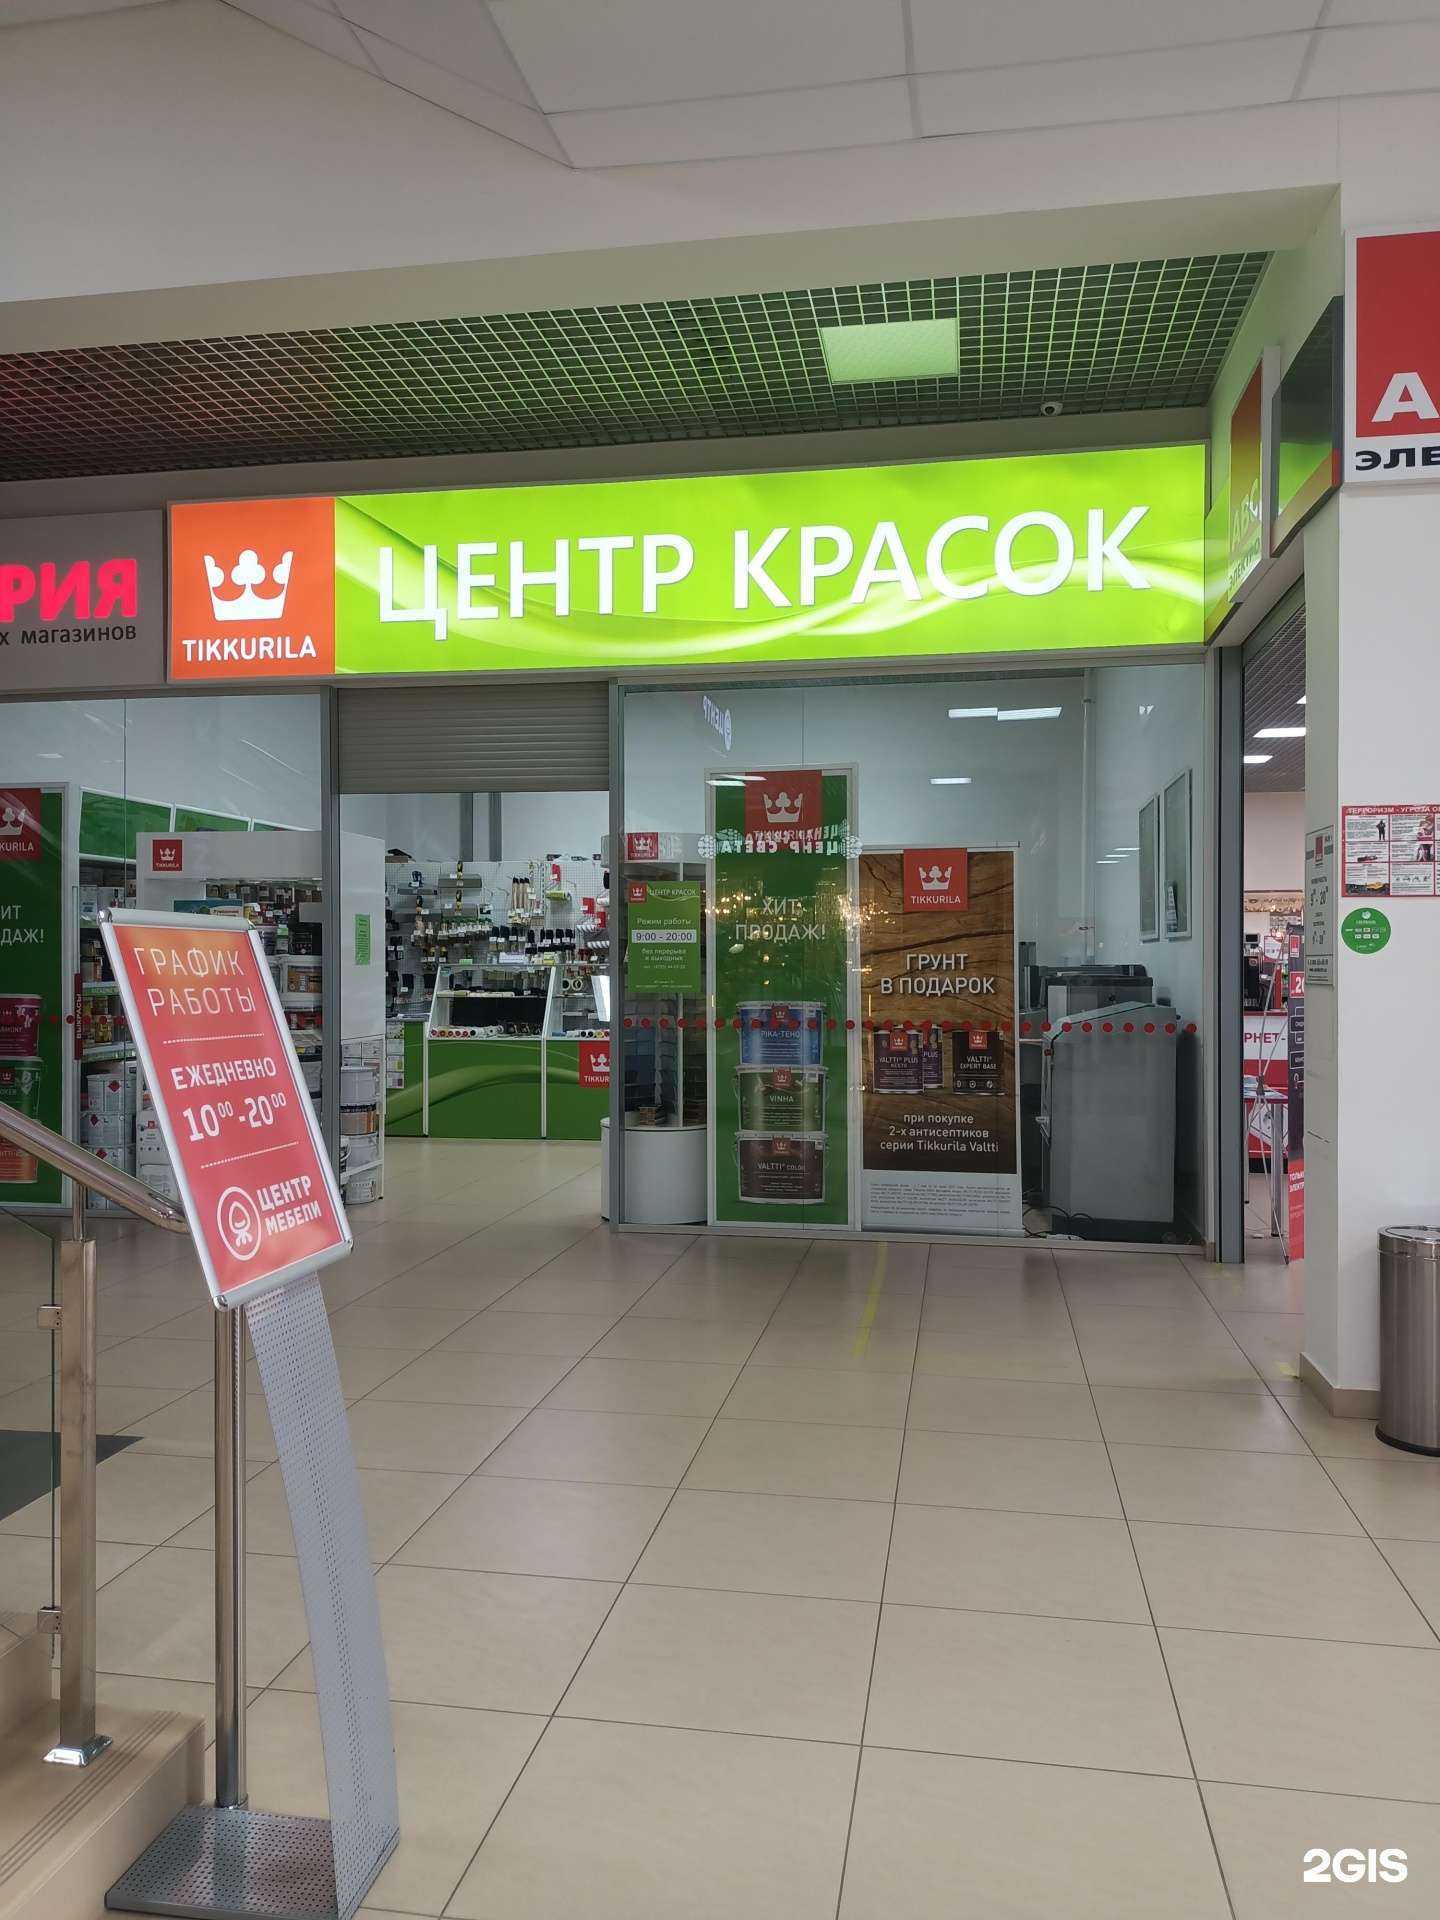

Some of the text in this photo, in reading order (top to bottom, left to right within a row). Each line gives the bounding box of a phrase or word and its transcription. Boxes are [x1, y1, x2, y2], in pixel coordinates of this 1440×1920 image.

[379, 505, 1153, 642] ЦЕНТР КРАСОК
[0, 557, 138, 623] РИЯ
[20, 625, 138, 645] магазинов
[182, 635, 317, 664] TIKKURILA
[649, 888, 697, 896] ЦЕНТР КРАСОК
[910, 895, 961, 904] TIKKURILA
[663, 917, 692, 926] работы
[636, 932, 657, 941] 9:00
[666, 932, 692, 941] 20:00
[736, 924, 826, 943] ПРОДАЖ!
[133, 946, 246, 977] ГРАФИК
[906, 953, 968, 970] ГРУНТ
[880, 977, 995, 997] В ПОДАРОК
[147, 986, 256, 1016] РАБОТЫ
[170, 1057, 277, 1090] ЕЖЕДНЕВНО
[769, 1095, 794, 1103] VINHA
[904, 1114, 974, 1124] при покупке
[889, 1126, 989, 1139] 2-х антисептиков
[880, 1140, 1000, 1153] серии Tikkurila Valtti
[255, 1176, 312, 1211] ЦЕНТР
[264, 1200, 322, 1236] МЕБЕЛИ
